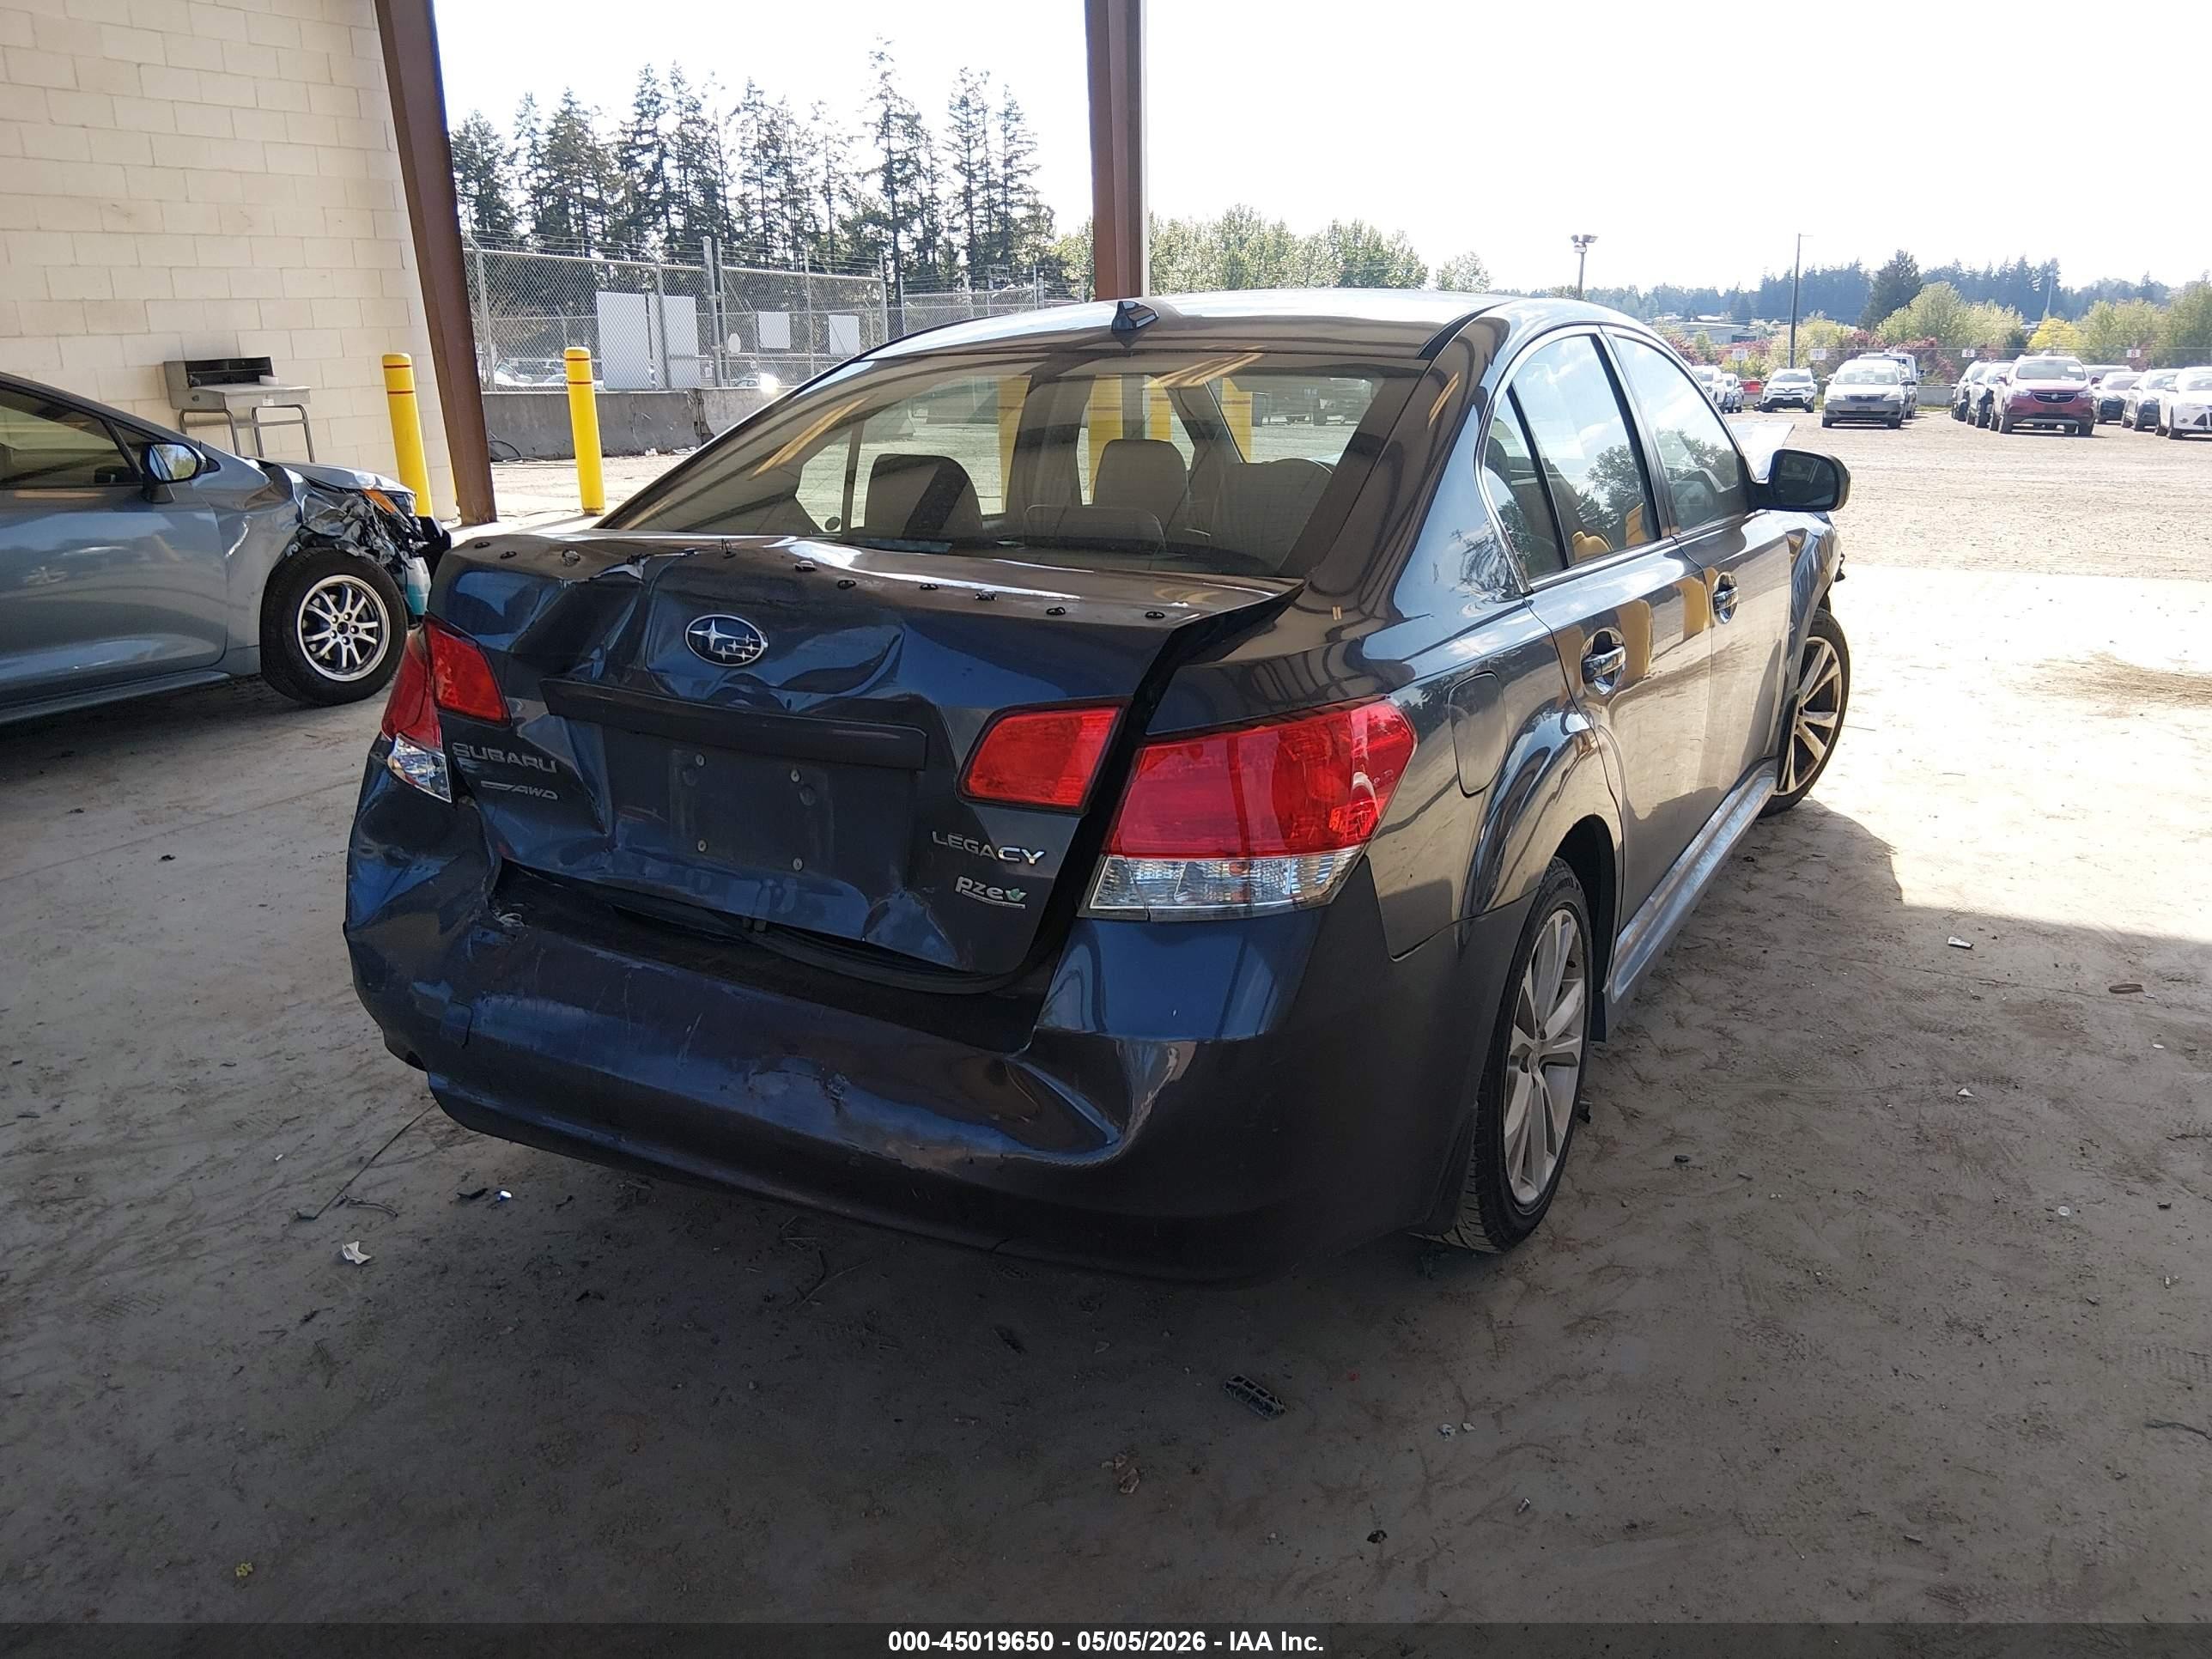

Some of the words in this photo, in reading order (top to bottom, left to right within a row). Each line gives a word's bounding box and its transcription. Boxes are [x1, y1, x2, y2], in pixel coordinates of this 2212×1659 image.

[453, 742, 557, 773] SUBARU
[510, 785, 558, 800] AWD
[932, 830, 1045, 864] LEGACY
